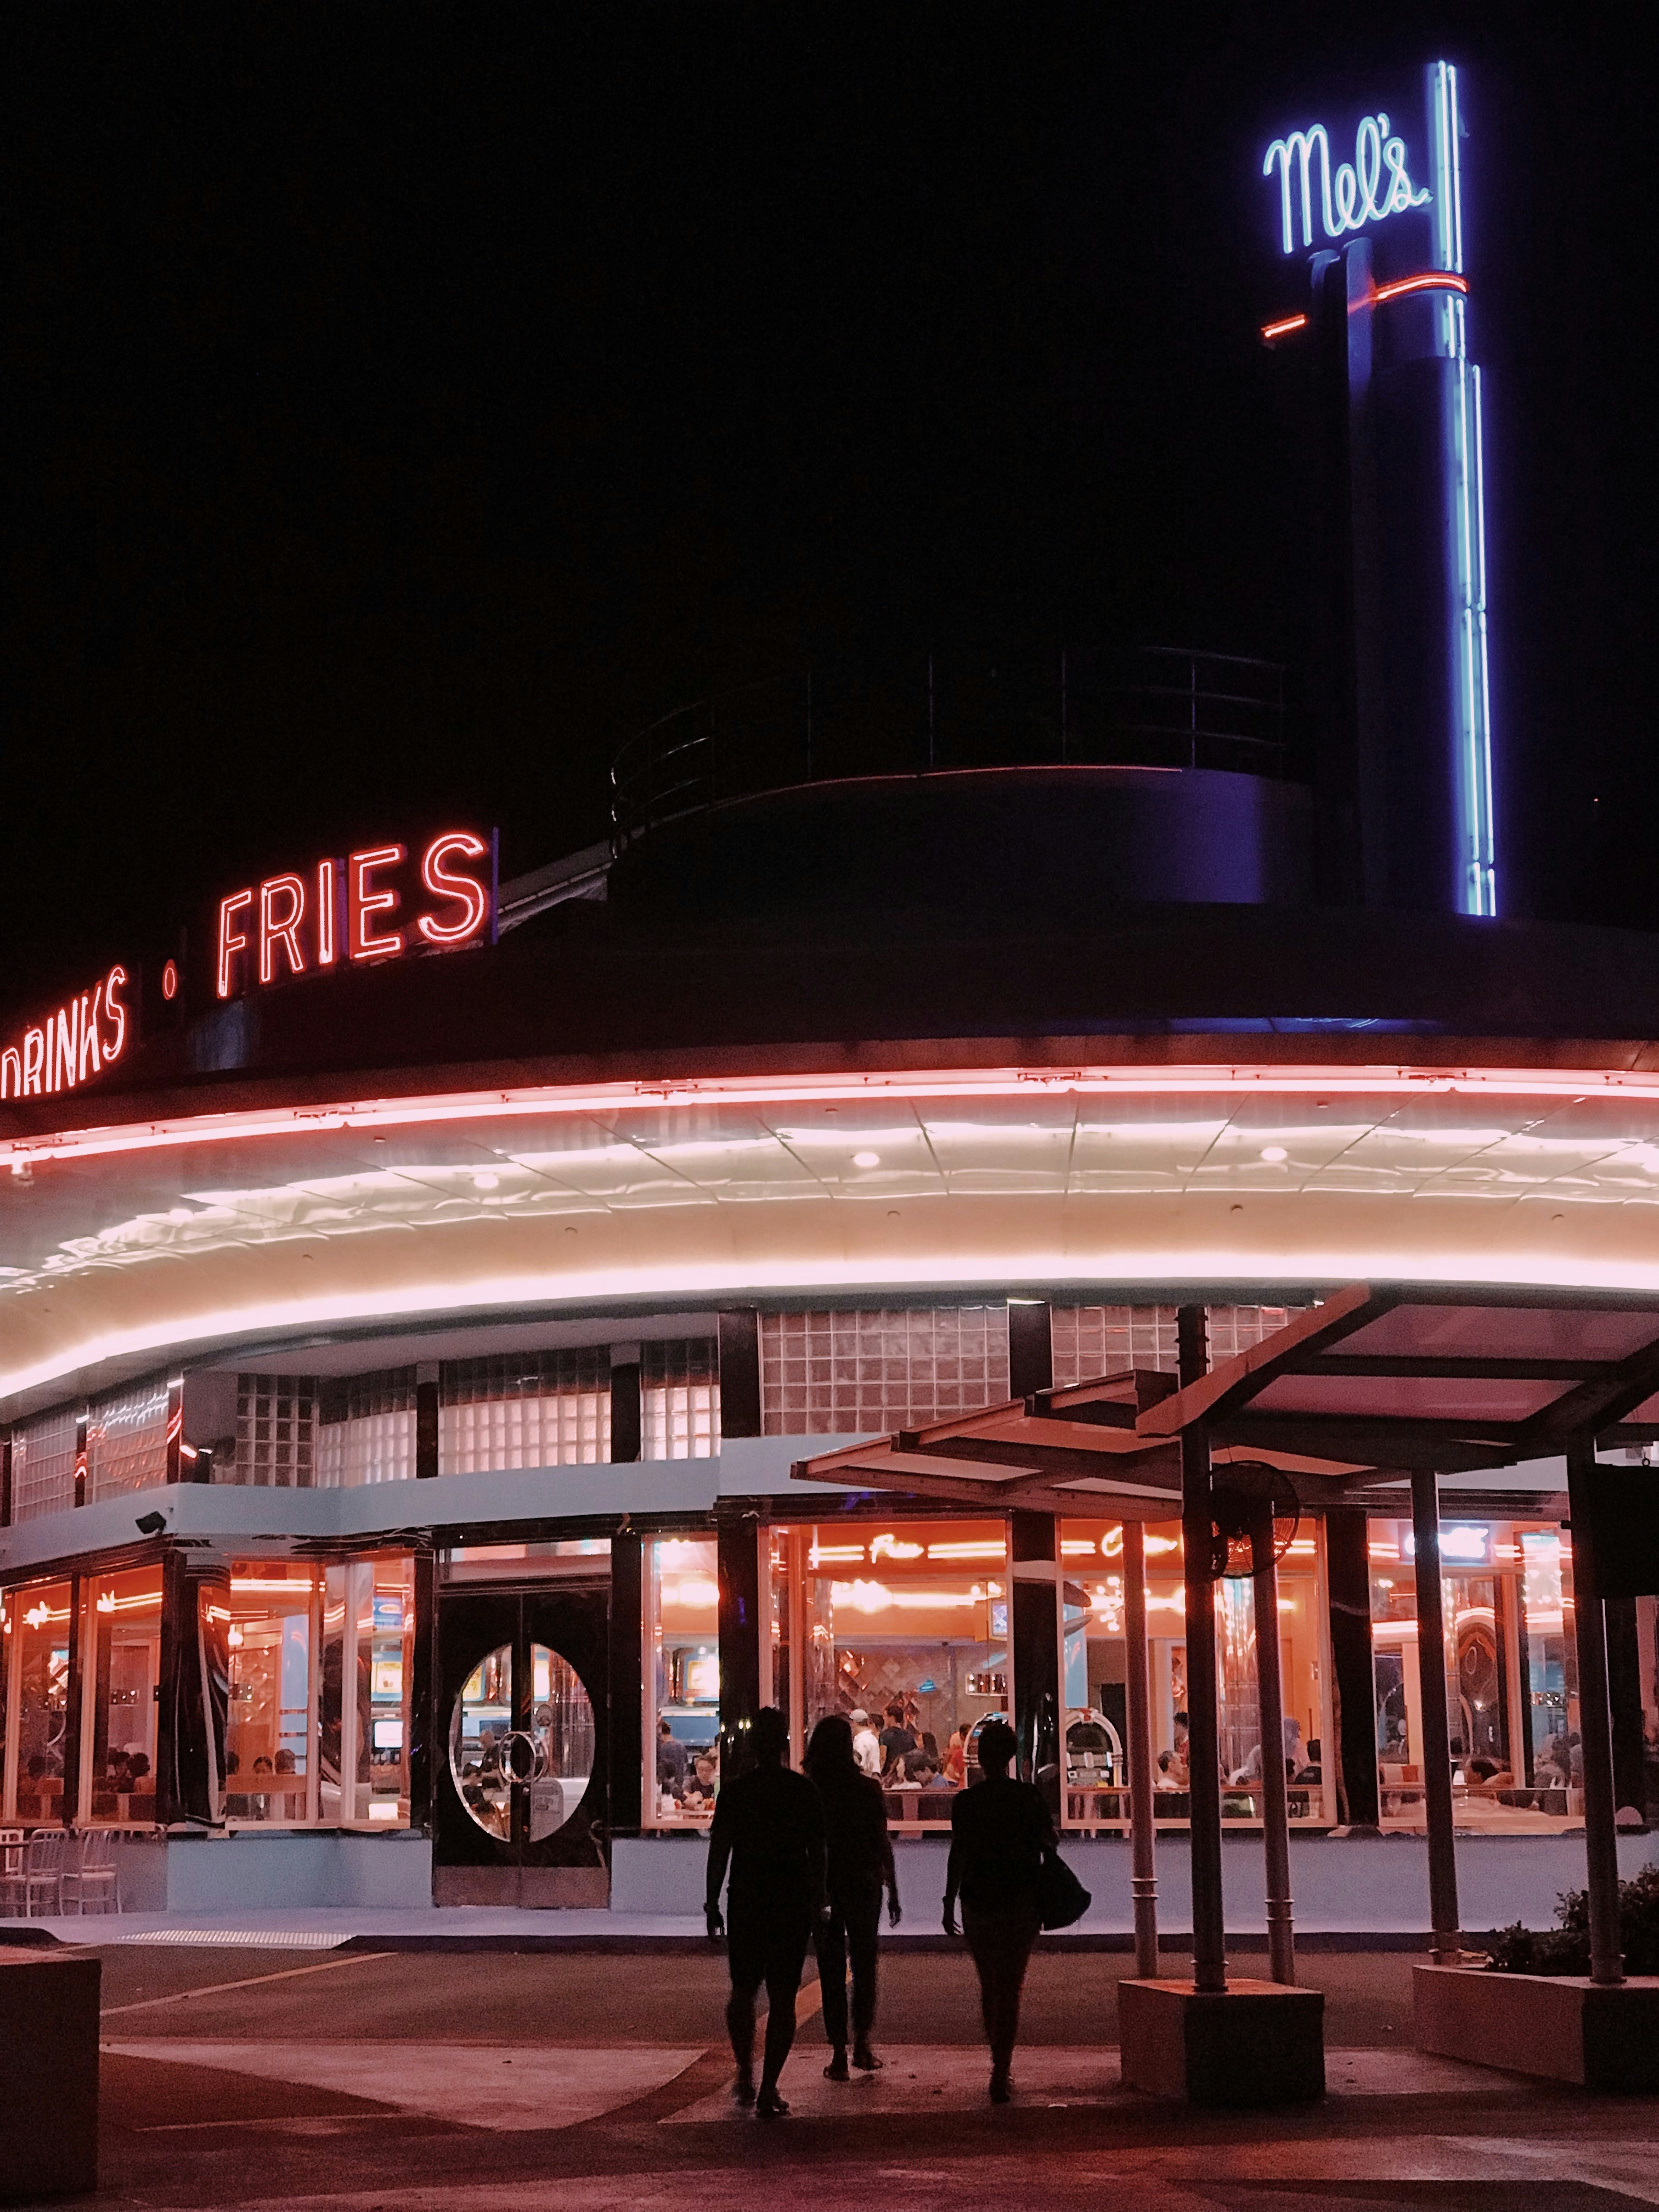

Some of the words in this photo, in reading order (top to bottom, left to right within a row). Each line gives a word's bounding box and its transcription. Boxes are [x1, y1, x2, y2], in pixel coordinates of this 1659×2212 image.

[1263, 113, 1432, 253] Mel's
[1, 965, 127, 1099] DRINKS
[218, 832, 486, 998] FRIES
